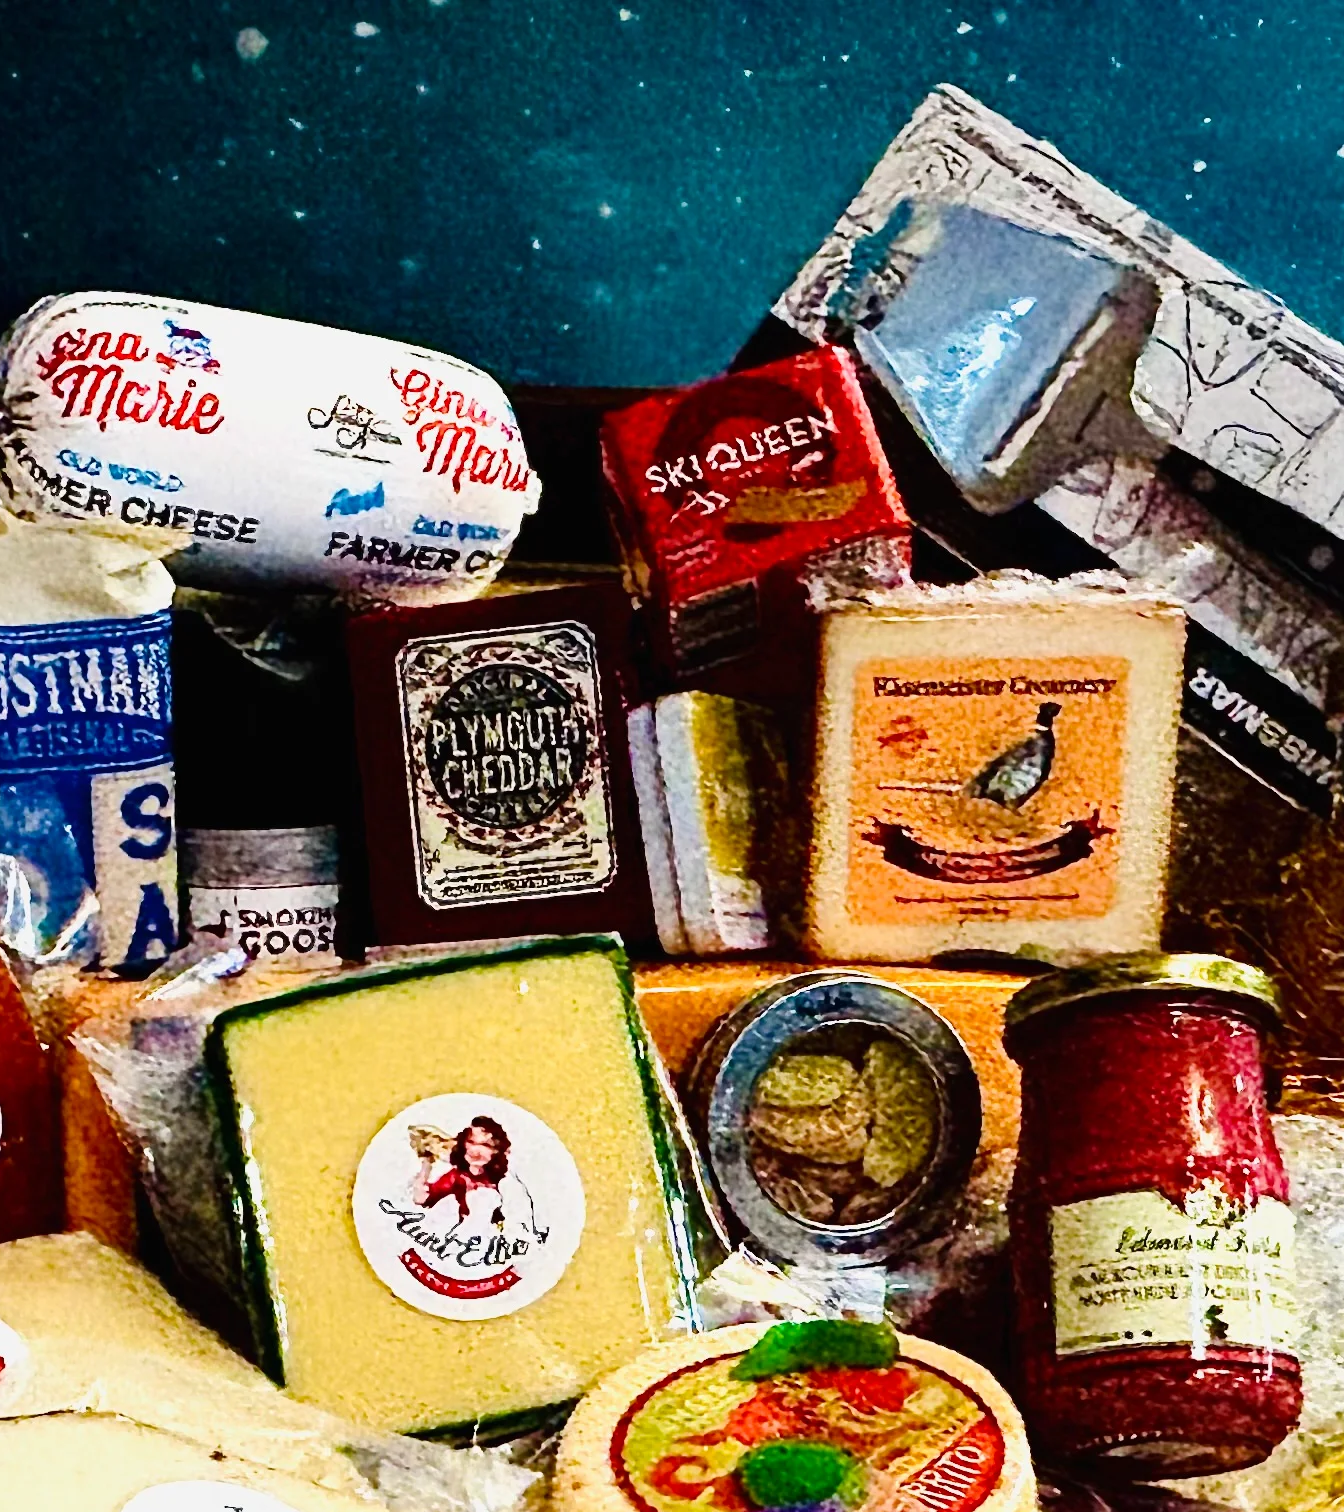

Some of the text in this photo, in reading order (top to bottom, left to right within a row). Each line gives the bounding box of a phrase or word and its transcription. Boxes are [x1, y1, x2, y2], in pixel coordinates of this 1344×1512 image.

[53, 364, 224, 435] Marie
[391, 367, 496, 425] Gina
[645, 405, 840, 493] SKI QUEEN
[120, 496, 261, 543] CHEESE
[324, 532, 460, 572] FARMER
[432, 704, 586, 757] PLYMOUTH
[442, 748, 573, 799] CHEDDAR
[238, 927, 334, 956] GOOS
[378, 1199, 453, 1261] Aunt
